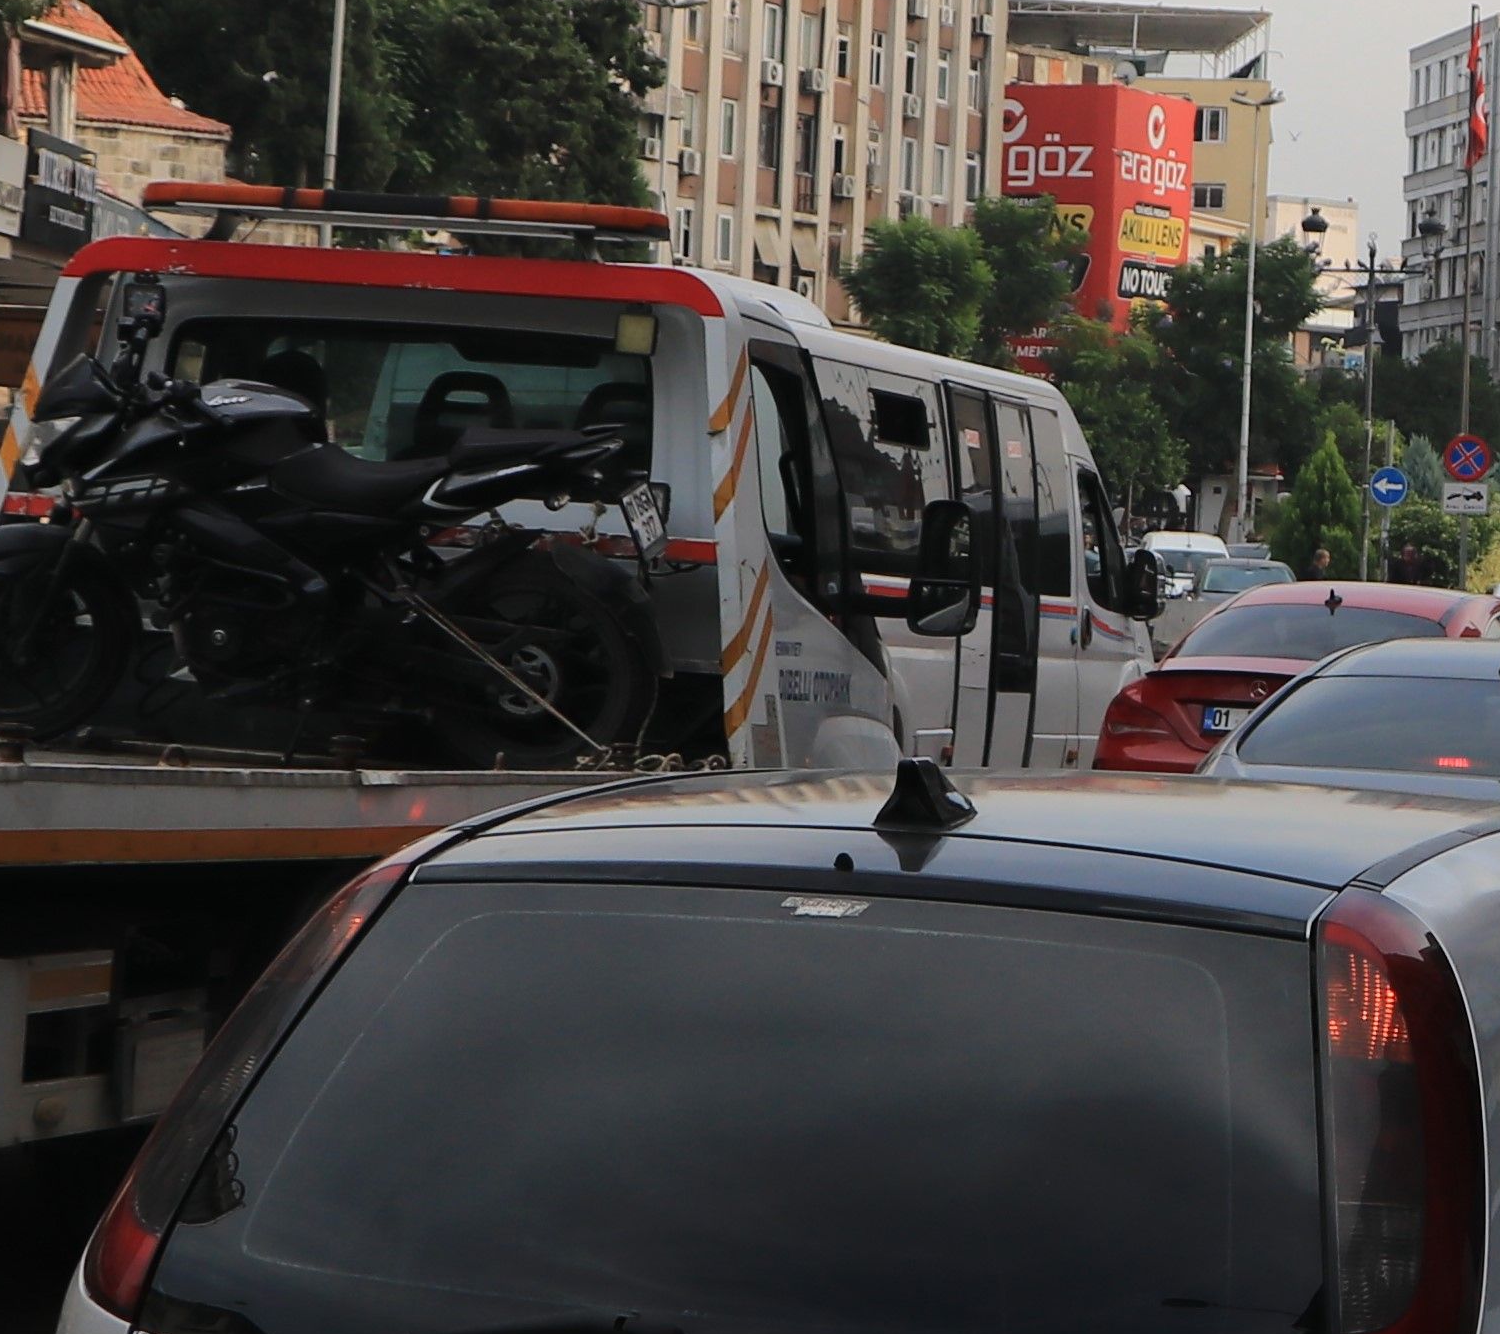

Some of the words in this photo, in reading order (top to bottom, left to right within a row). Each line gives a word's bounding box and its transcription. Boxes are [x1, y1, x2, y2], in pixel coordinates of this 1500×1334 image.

[1006, 132, 1095, 188] göz
[1120, 149, 1152, 185] era
[1153, 149, 1188, 197] göz
[1155, 223, 1183, 249] LENS
[1120, 266, 1140, 293] NO
